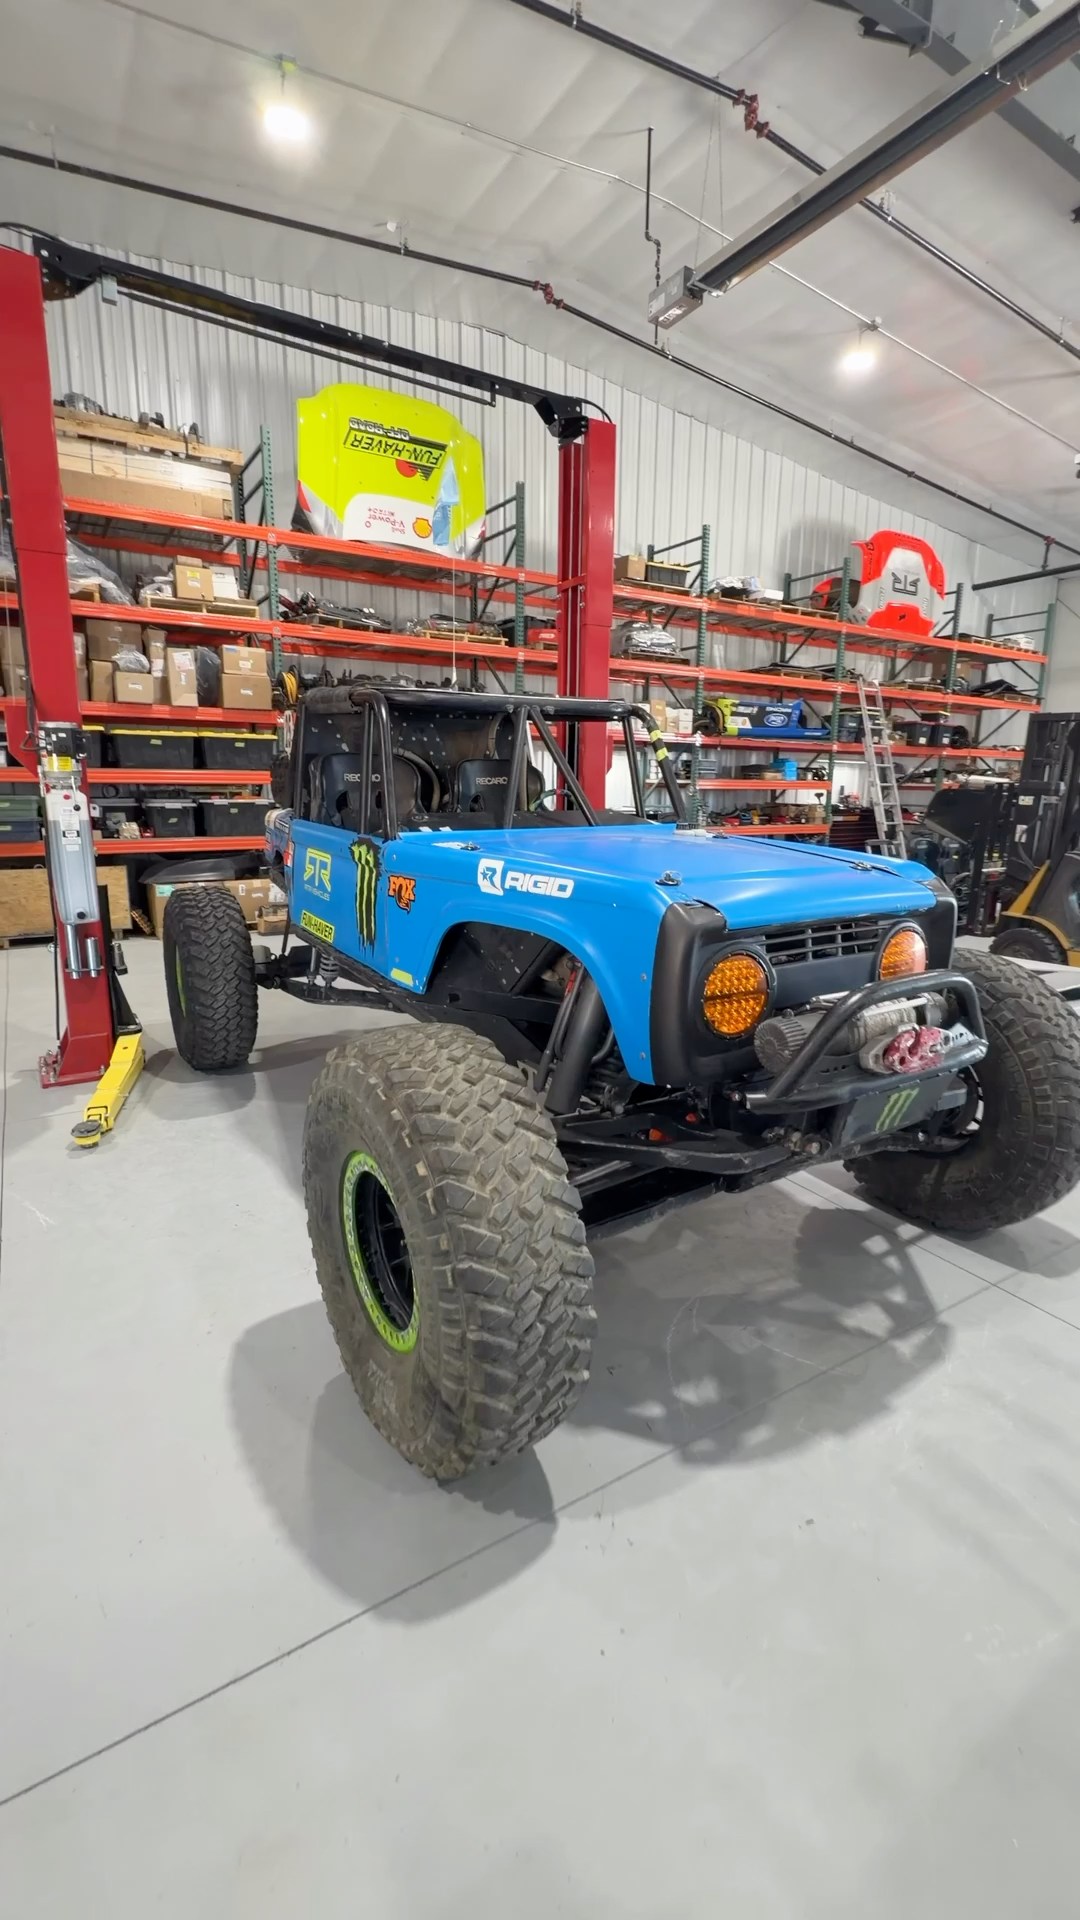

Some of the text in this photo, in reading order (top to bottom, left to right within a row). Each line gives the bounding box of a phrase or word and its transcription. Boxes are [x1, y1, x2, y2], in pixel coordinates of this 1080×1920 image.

[350, 433, 443, 466] FUN-HAVER
[368, 514, 405, 529] V-Power
[476, 777, 508, 785] RECARO
[389, 875, 416, 902] FOX
[504, 870, 575, 899] RIGID
[302, 912, 333, 941] FUN-HAVER
